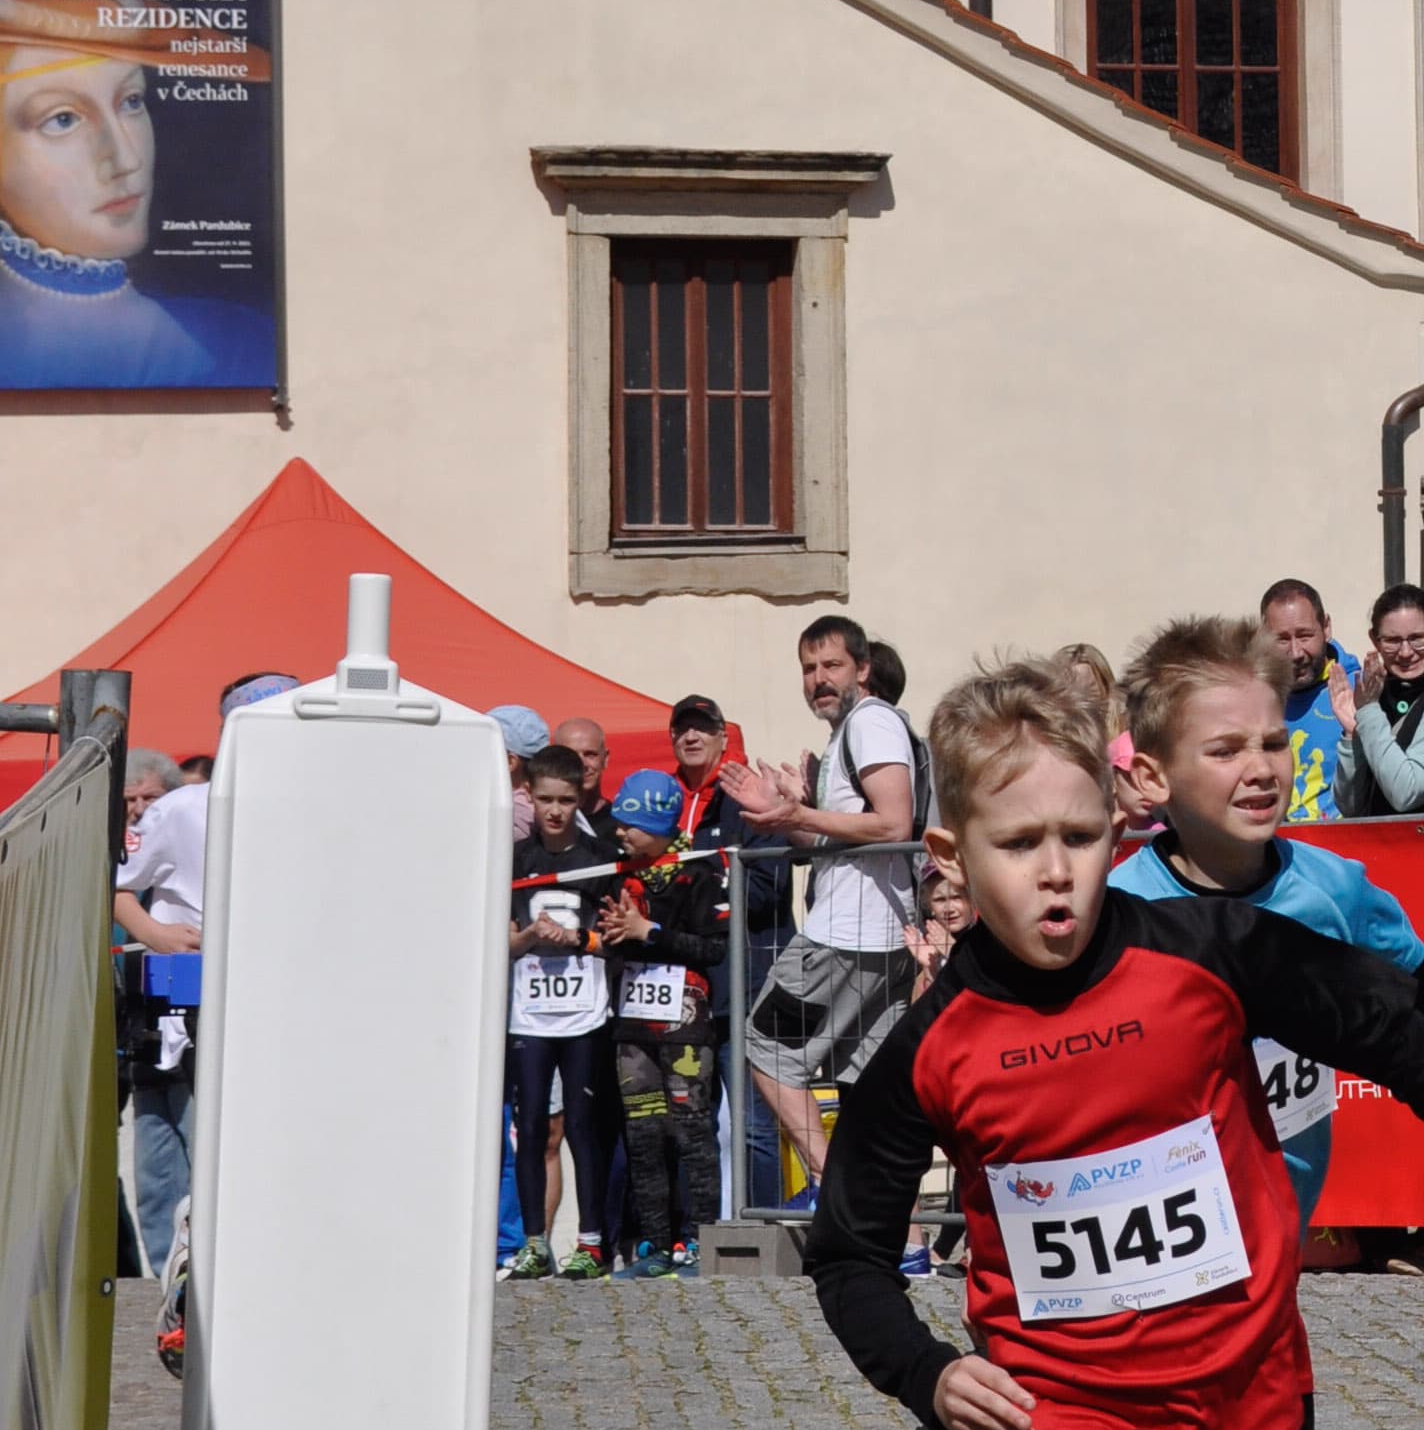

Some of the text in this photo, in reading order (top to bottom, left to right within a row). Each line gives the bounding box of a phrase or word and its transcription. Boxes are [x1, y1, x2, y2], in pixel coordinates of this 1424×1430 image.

[97, 7, 248, 29] REZIDENCE
[170, 36, 248, 55] nejstarší
[157, 64, 249, 77] renesance
[157, 82, 248, 101] v Čechách
[529, 976, 584, 999] 5107
[625, 981, 672, 1005] 2138
[1000, 1019, 1144, 1069] GIVOVA
[1263, 1054, 1320, 1110] 48
[1187, 1149, 1207, 1166] run
[1090, 1158, 1142, 1183] PVZP
[1031, 1187, 1208, 1280] 5145
[1048, 1297, 1083, 1309] PVZP
